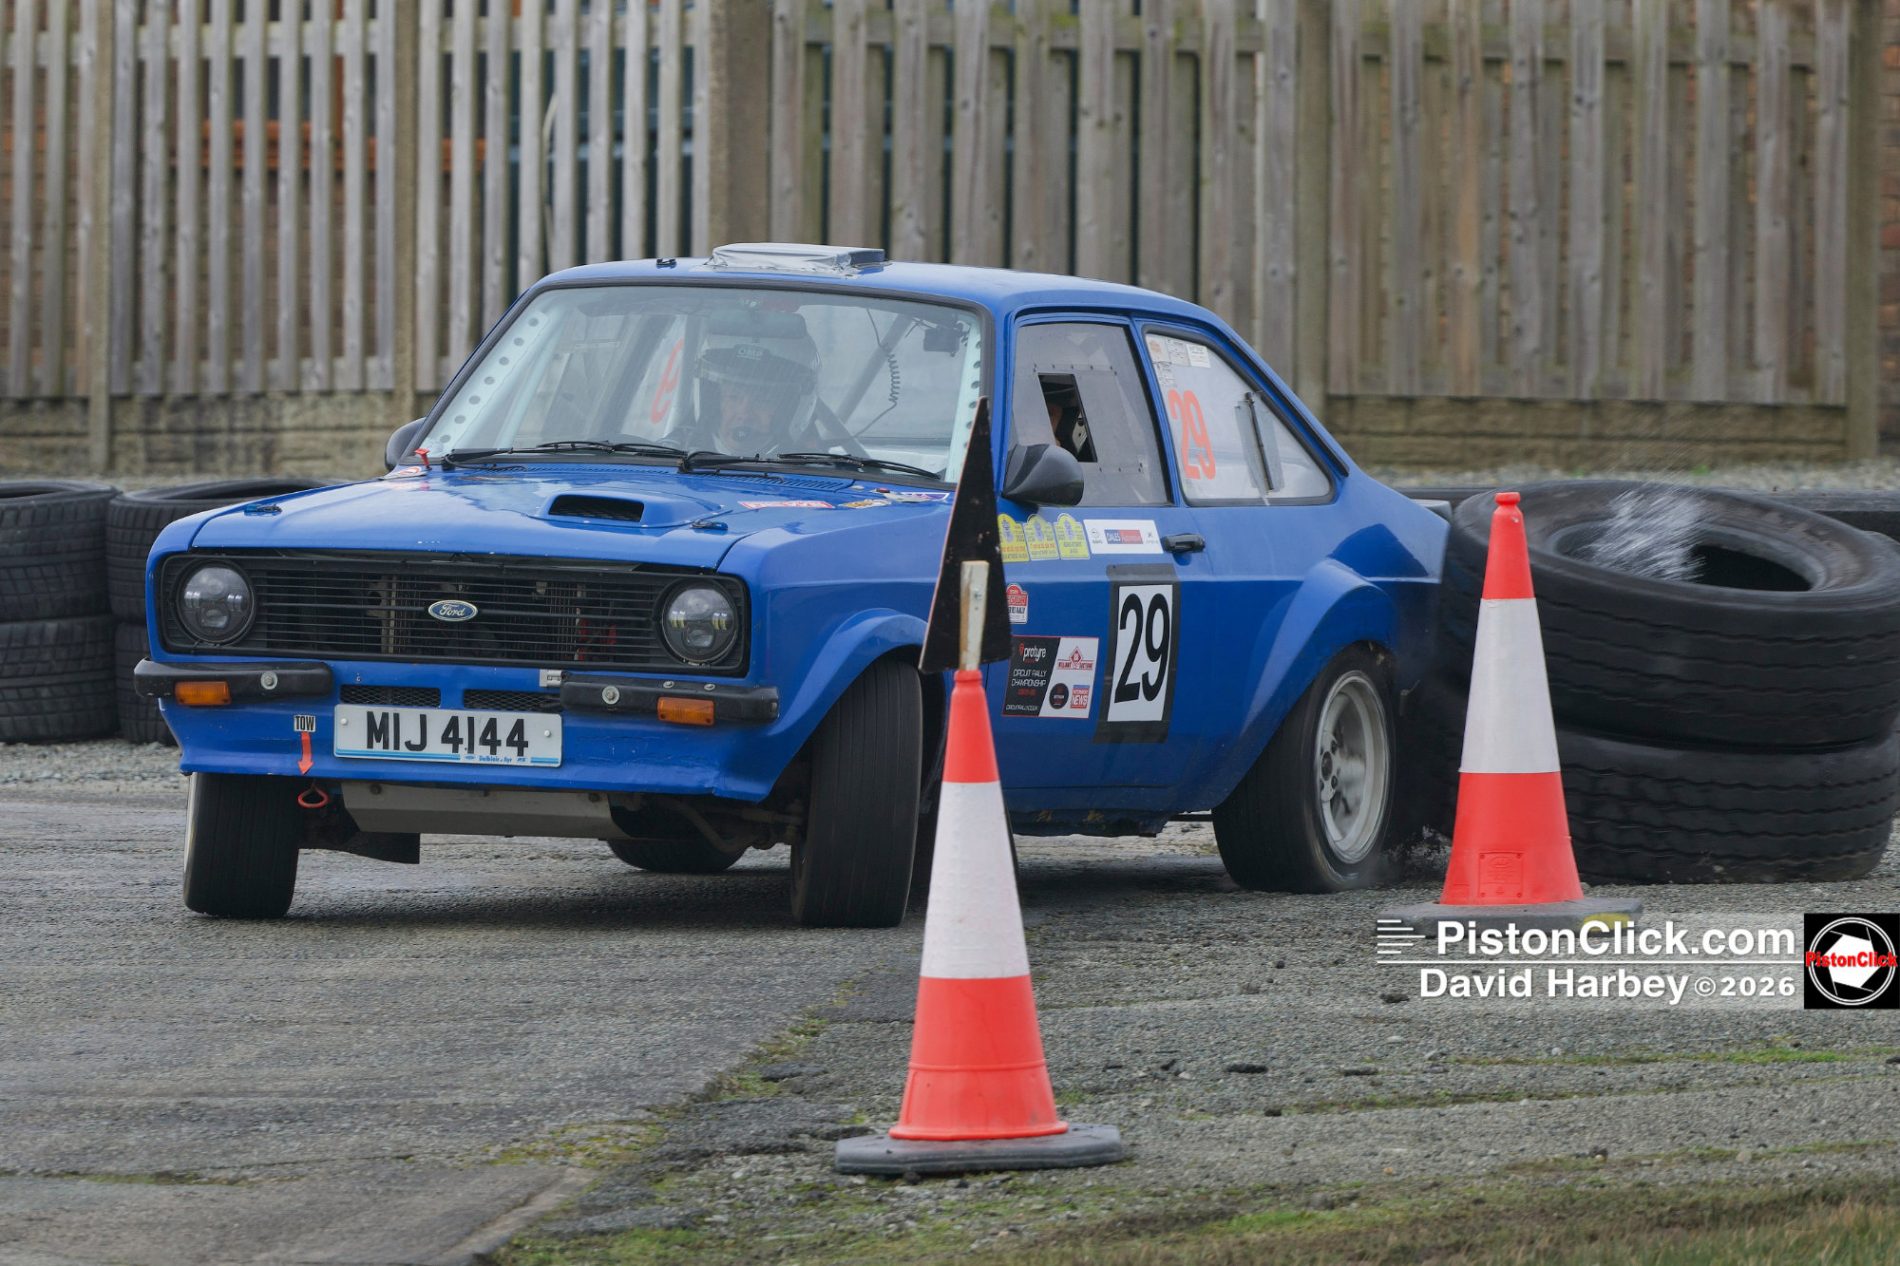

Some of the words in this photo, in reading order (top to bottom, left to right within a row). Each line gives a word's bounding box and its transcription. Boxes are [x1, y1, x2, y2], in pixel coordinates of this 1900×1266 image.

[1168, 389, 1216, 480] 29
[440, 603, 466, 616] Ford
[1023, 645, 1046, 661] protyre
[1114, 593, 1171, 704] 29
[295, 715, 315, 731] TOW
[366, 711, 427, 752] MIJ
[441, 715, 528, 757] 4144
